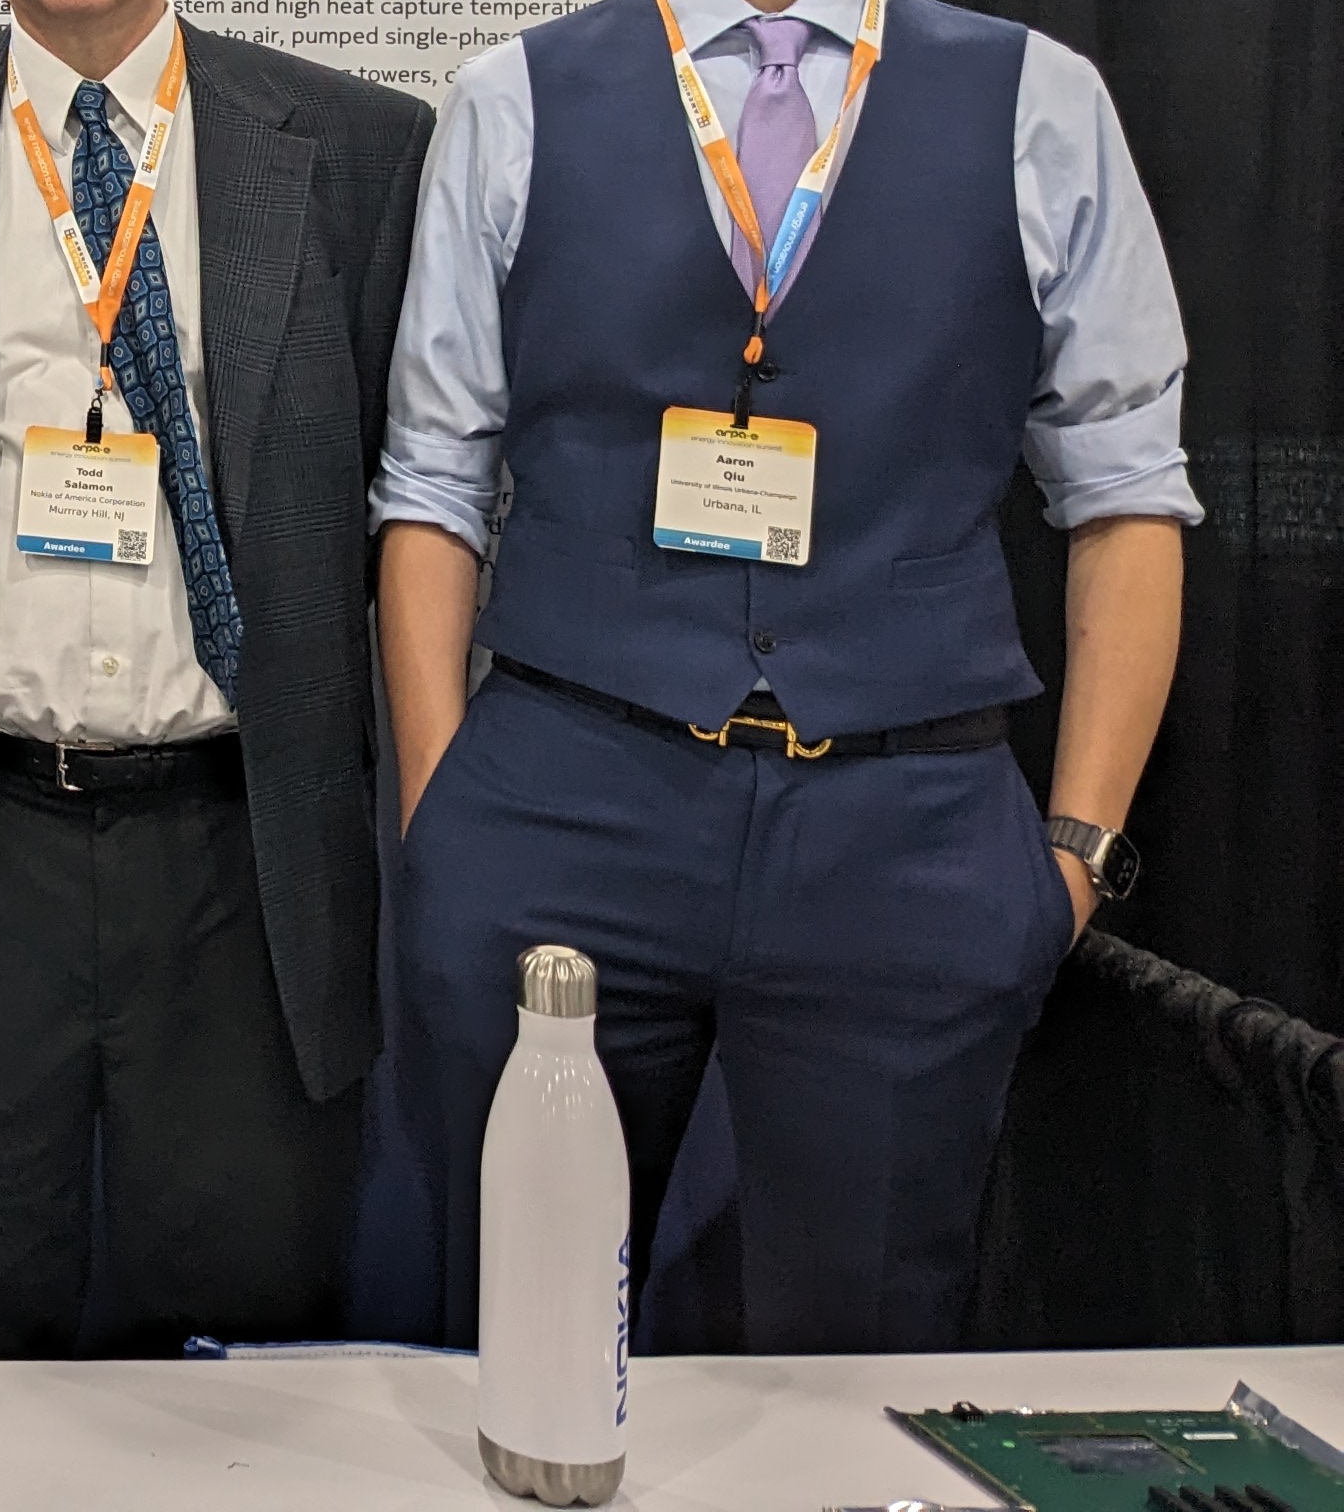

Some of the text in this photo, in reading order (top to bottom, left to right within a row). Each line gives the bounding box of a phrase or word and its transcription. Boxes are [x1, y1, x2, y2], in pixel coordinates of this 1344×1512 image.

[252, 26, 284, 47] air,
[292, 26, 379, 49] pumped
[385, 26, 523, 50] single-phas
[358, 66, 438, 87] towers,
[774, 201, 807, 274] energy innovation
[74, 241, 93, 279] AMERICAN
[716, 454, 755, 468] Aaron
[76, 467, 103, 478] Todd
[723, 470, 745, 483] Qiu
[64, 480, 114, 492] Salamon
[30, 490, 53, 499] Nokia
[64, 493, 97, 503] America
[99, 496, 146, 508] Corporation
[703, 497, 762, 515] Urbana, IL
[91, 509, 111, 520] Hill,
[113, 511, 125, 522] NJ
[43, 541, 86, 553] Awardee
[683, 536, 731, 551] Awardee
